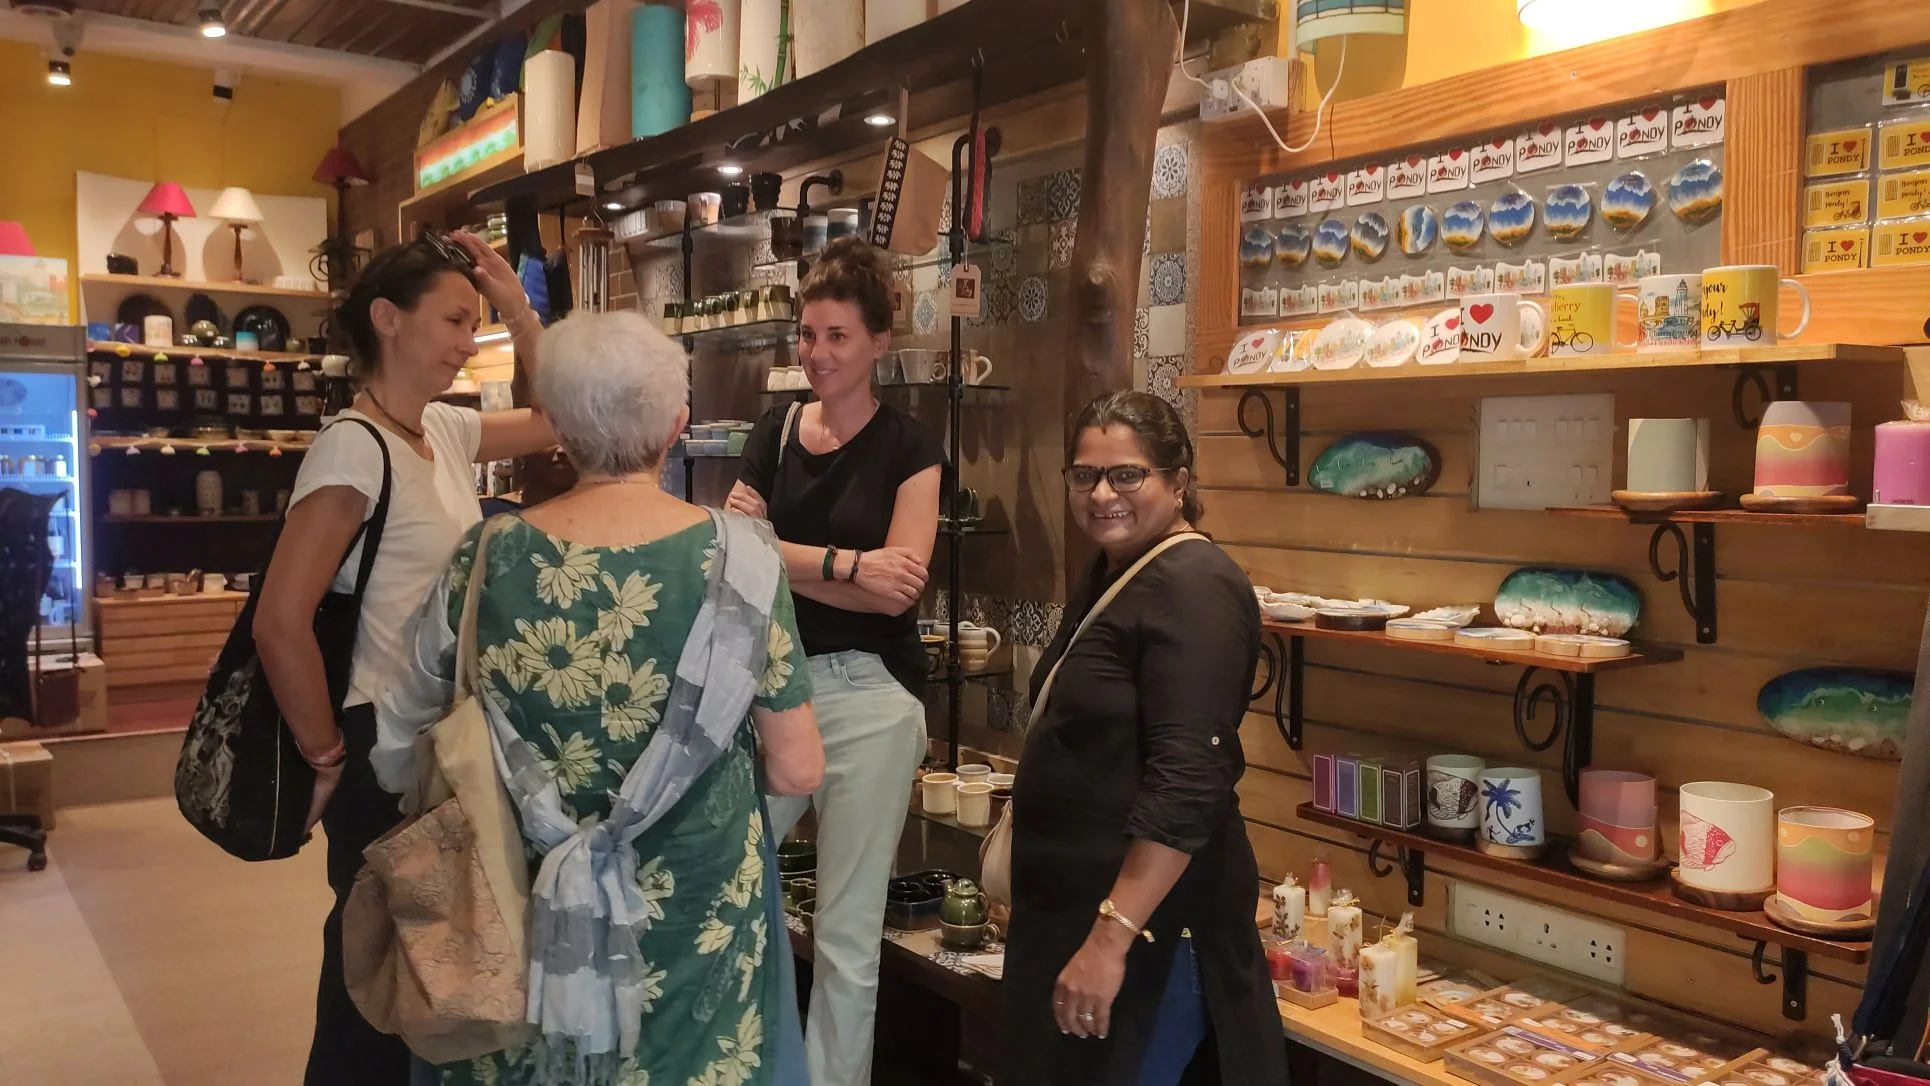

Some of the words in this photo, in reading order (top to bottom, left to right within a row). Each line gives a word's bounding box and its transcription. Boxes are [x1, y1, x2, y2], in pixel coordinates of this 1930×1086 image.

[1683, 101, 1693, 114] I
[1907, 133, 1916, 146] I
[1830, 142, 1839, 155] I
[1904, 145, 1930, 156] POND
[1827, 154, 1860, 165] PONDY
[1899, 233, 1909, 246] I
[1828, 241, 1836, 253] I
[1896, 245, 1930, 255] PONDY
[1824, 253, 1857, 263] PONDY
[1430, 324, 1440, 338] I
[1241, 343, 1248, 353] I
[1422, 334, 1459, 357] POND
